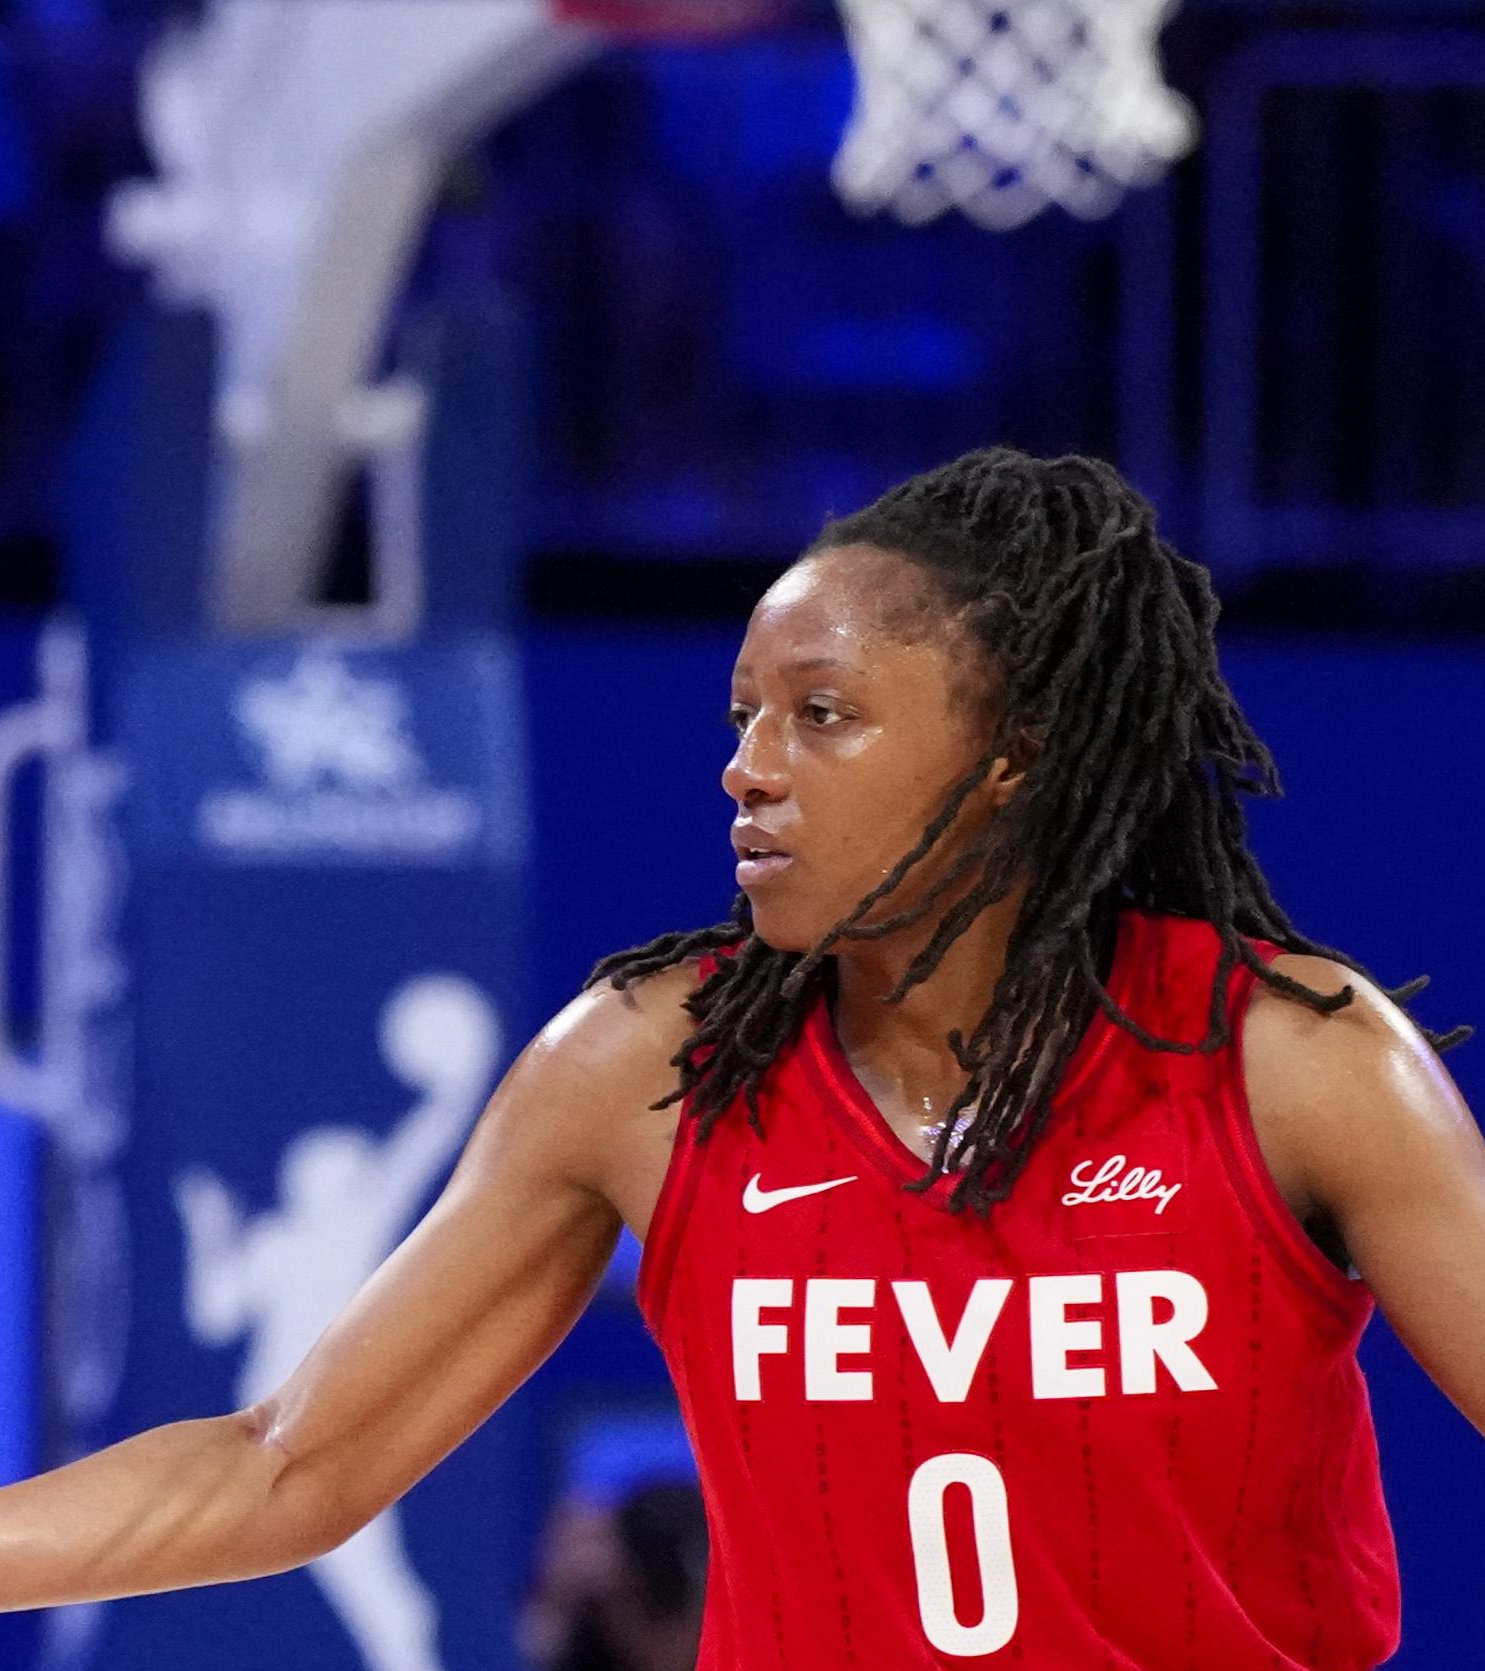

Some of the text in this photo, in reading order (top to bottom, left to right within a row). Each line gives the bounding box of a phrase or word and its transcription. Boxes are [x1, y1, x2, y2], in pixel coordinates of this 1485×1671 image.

[1061, 1154, 1182, 1215] Lilly
[731, 1269, 1219, 1403] FEVER
[907, 1453, 1019, 1657] 0
